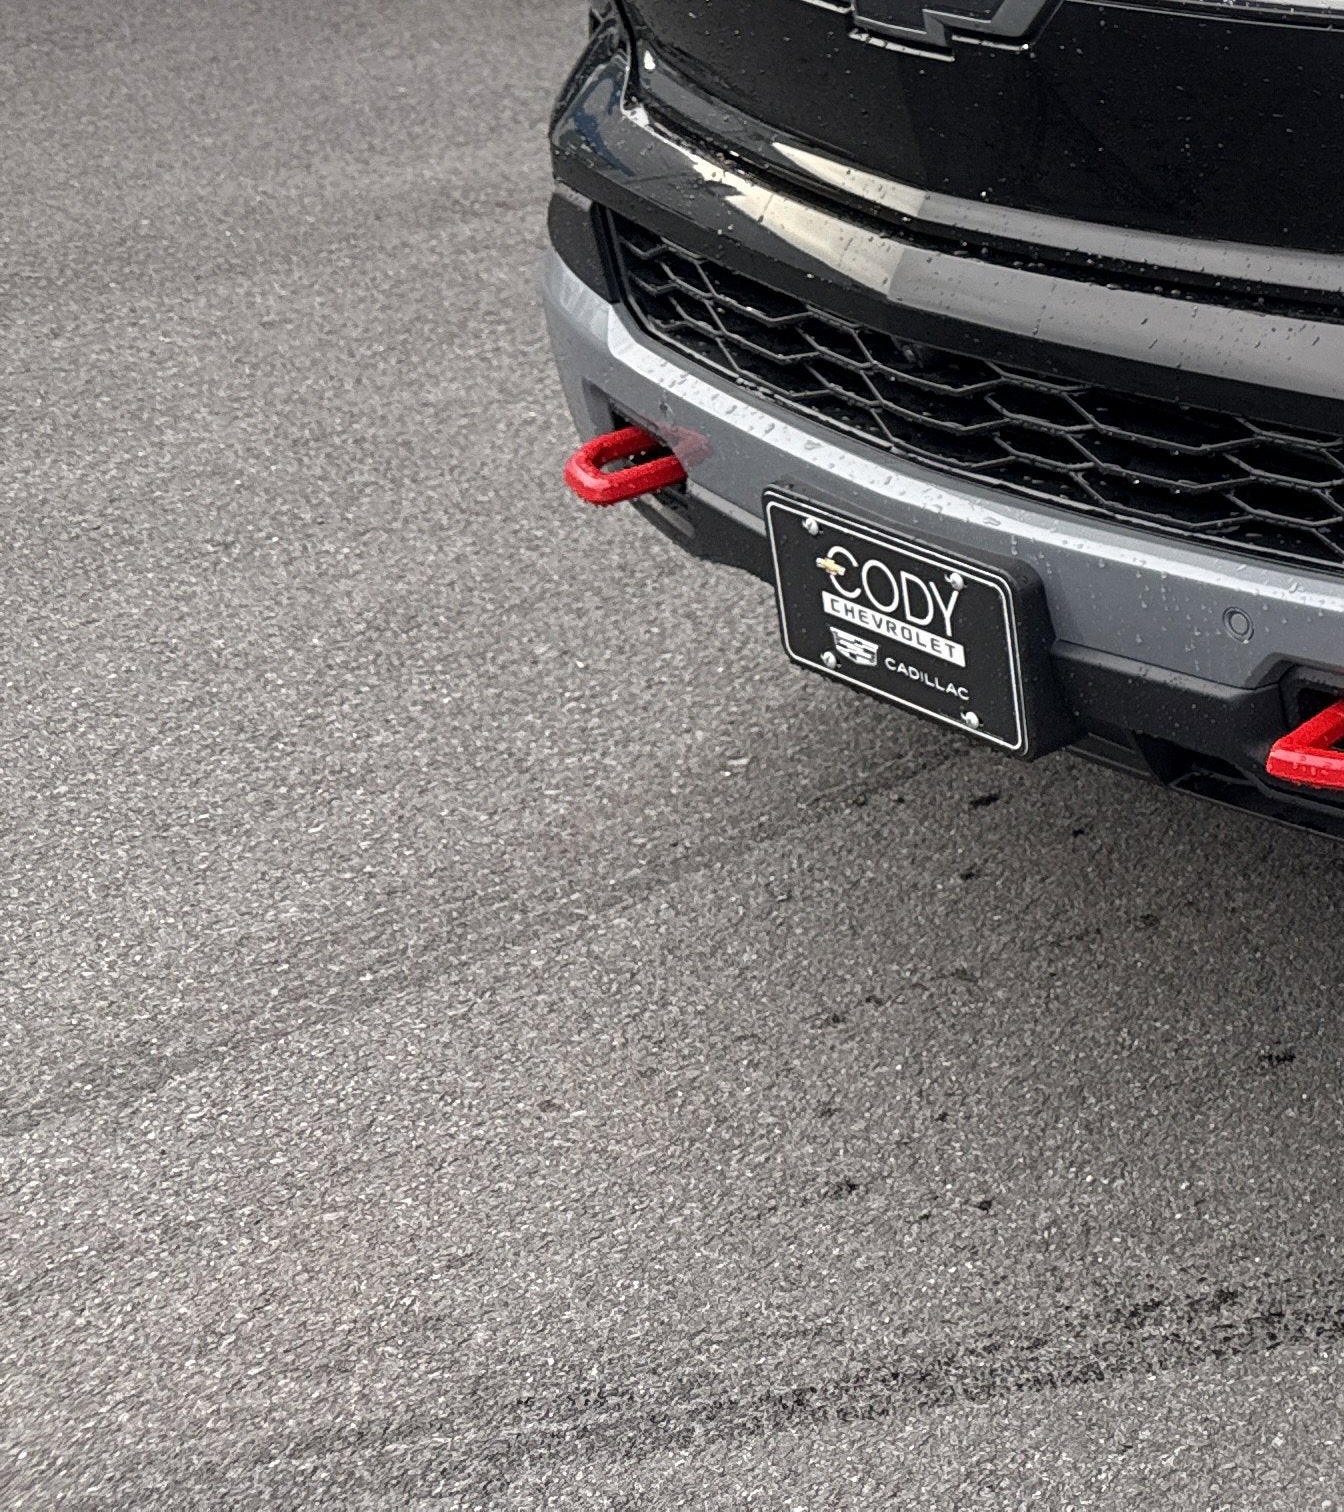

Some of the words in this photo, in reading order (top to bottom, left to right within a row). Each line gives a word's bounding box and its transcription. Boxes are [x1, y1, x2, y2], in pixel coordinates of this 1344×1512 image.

[826, 545, 960, 637] CODY
[829, 597, 957, 660] CHEVROLET
[884, 656, 970, 701] CADILLAC
